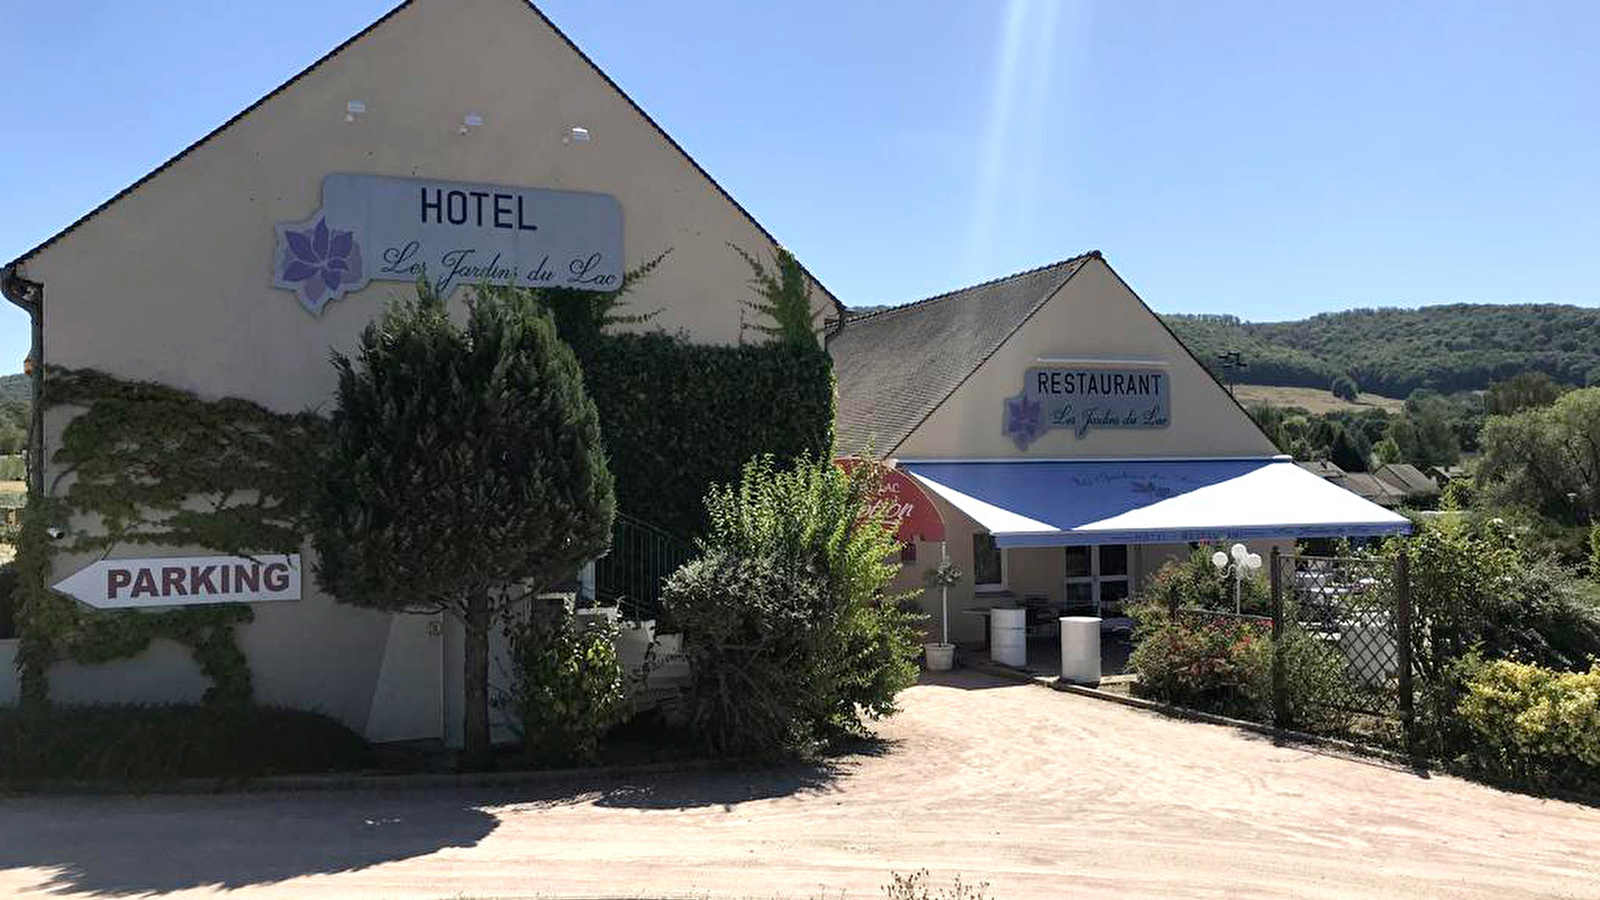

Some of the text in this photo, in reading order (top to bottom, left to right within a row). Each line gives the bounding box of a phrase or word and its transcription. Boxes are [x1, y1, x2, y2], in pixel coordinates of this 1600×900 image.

[421, 187, 538, 231] HOTEL
[382, 241, 427, 275] Les
[526, 258, 553, 282] du
[568, 253, 617, 286] Lac
[1037, 372, 1162, 396] RESTAURANT
[1052, 403, 1168, 438] Les Jardins du Lac
[107, 562, 290, 599] PARKING
